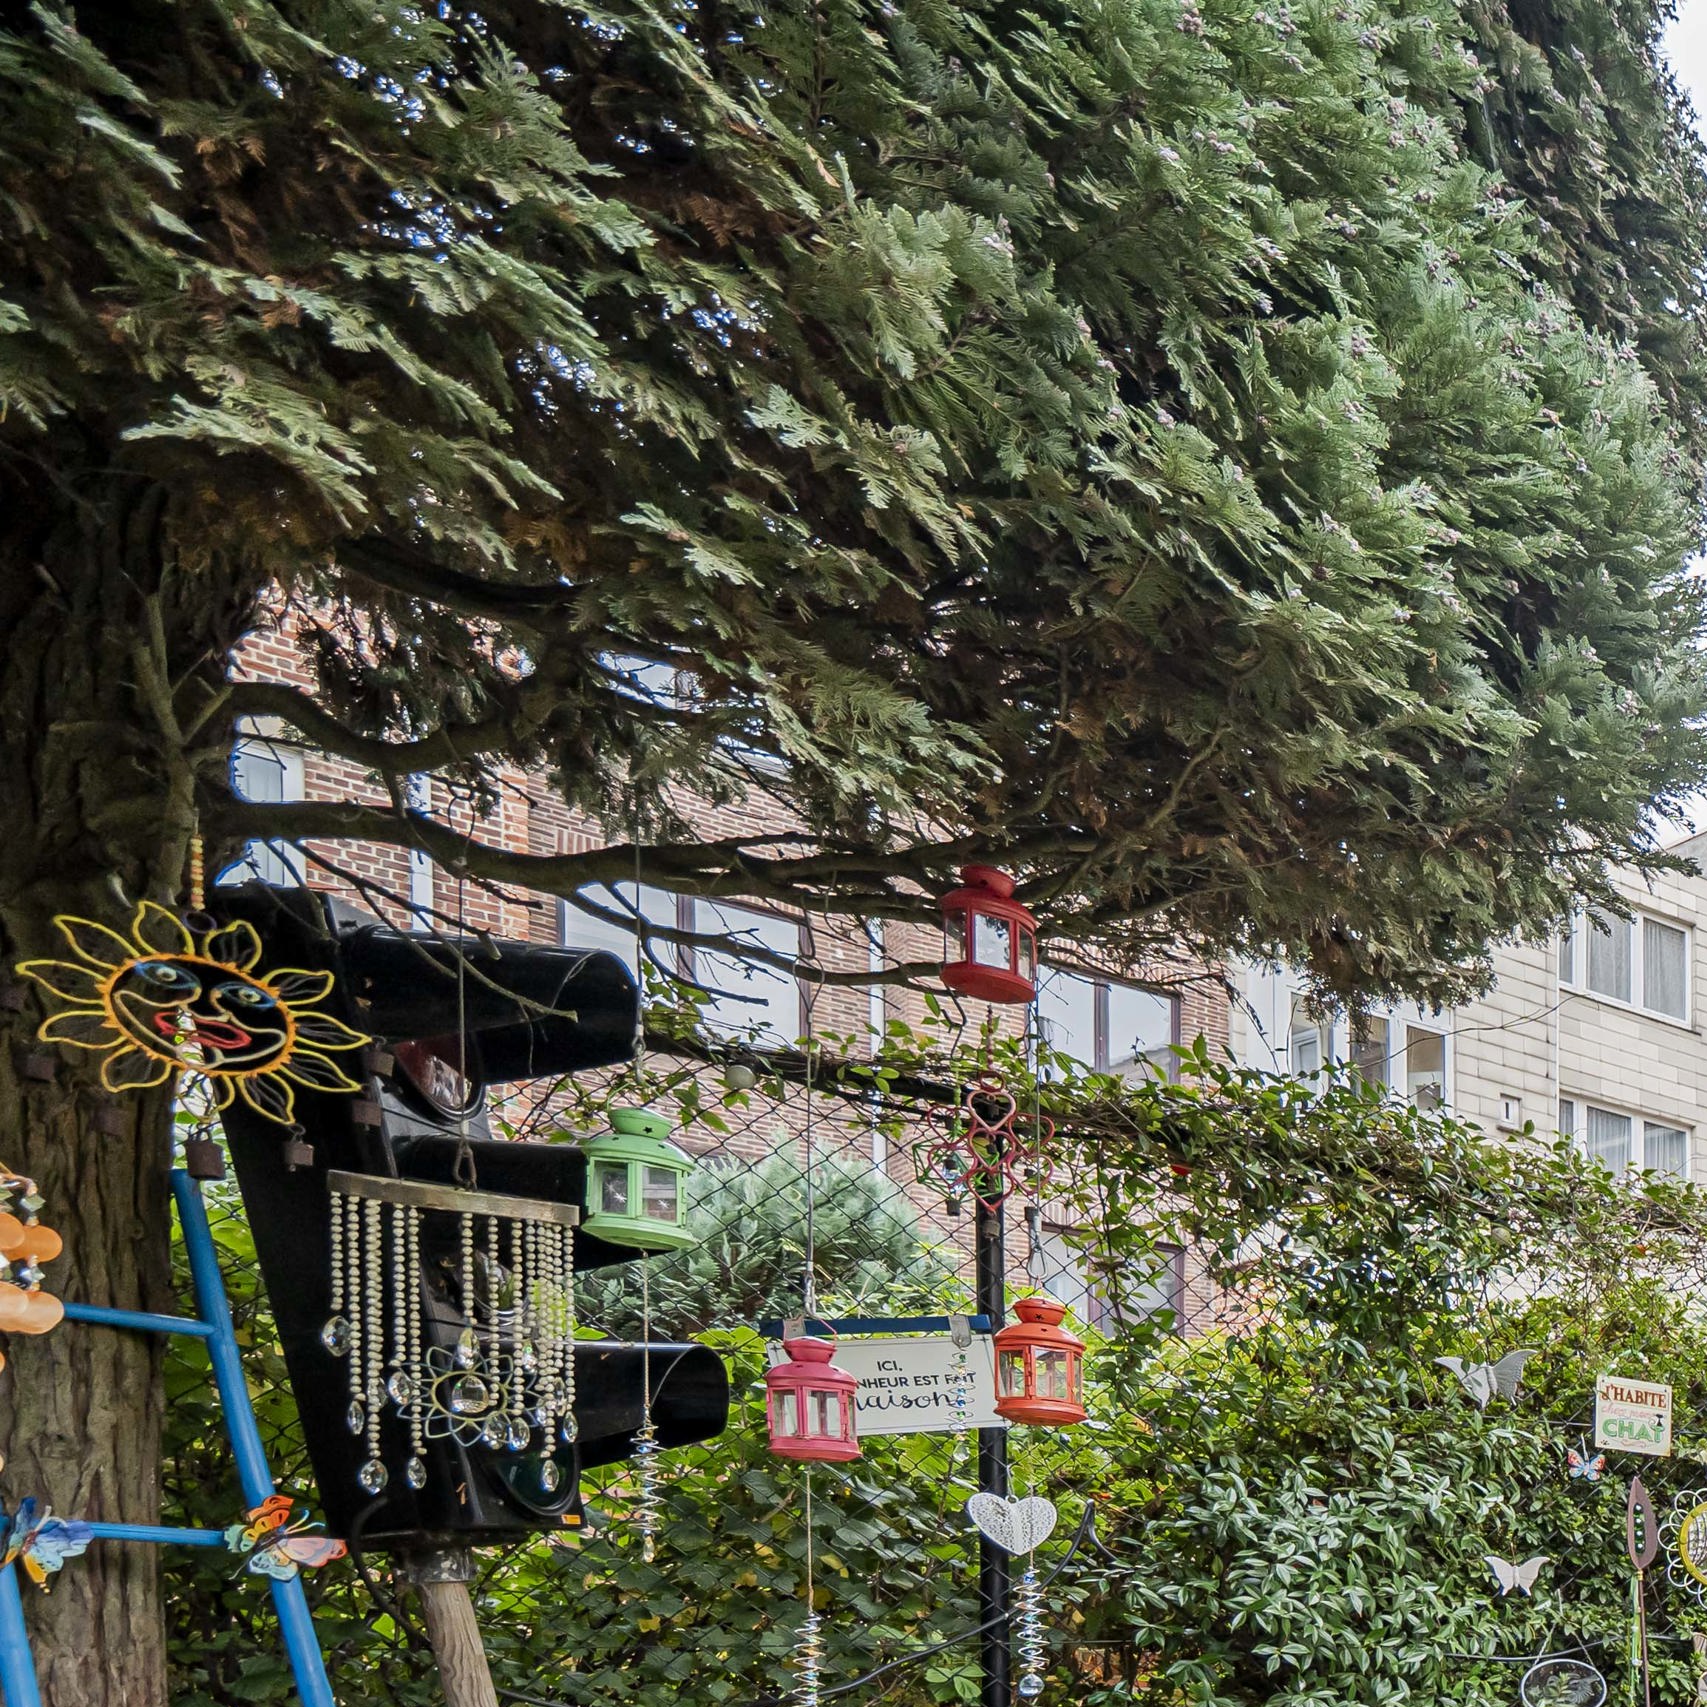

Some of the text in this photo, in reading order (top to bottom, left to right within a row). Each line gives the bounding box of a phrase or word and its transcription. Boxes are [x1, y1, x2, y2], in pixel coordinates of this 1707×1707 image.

[856, 1376, 909, 1390] NHEUR
[913, 1374, 940, 1387] EST
[1601, 1384, 1667, 1408] J'HABITE
[1602, 1419, 1666, 1444] CHAT
